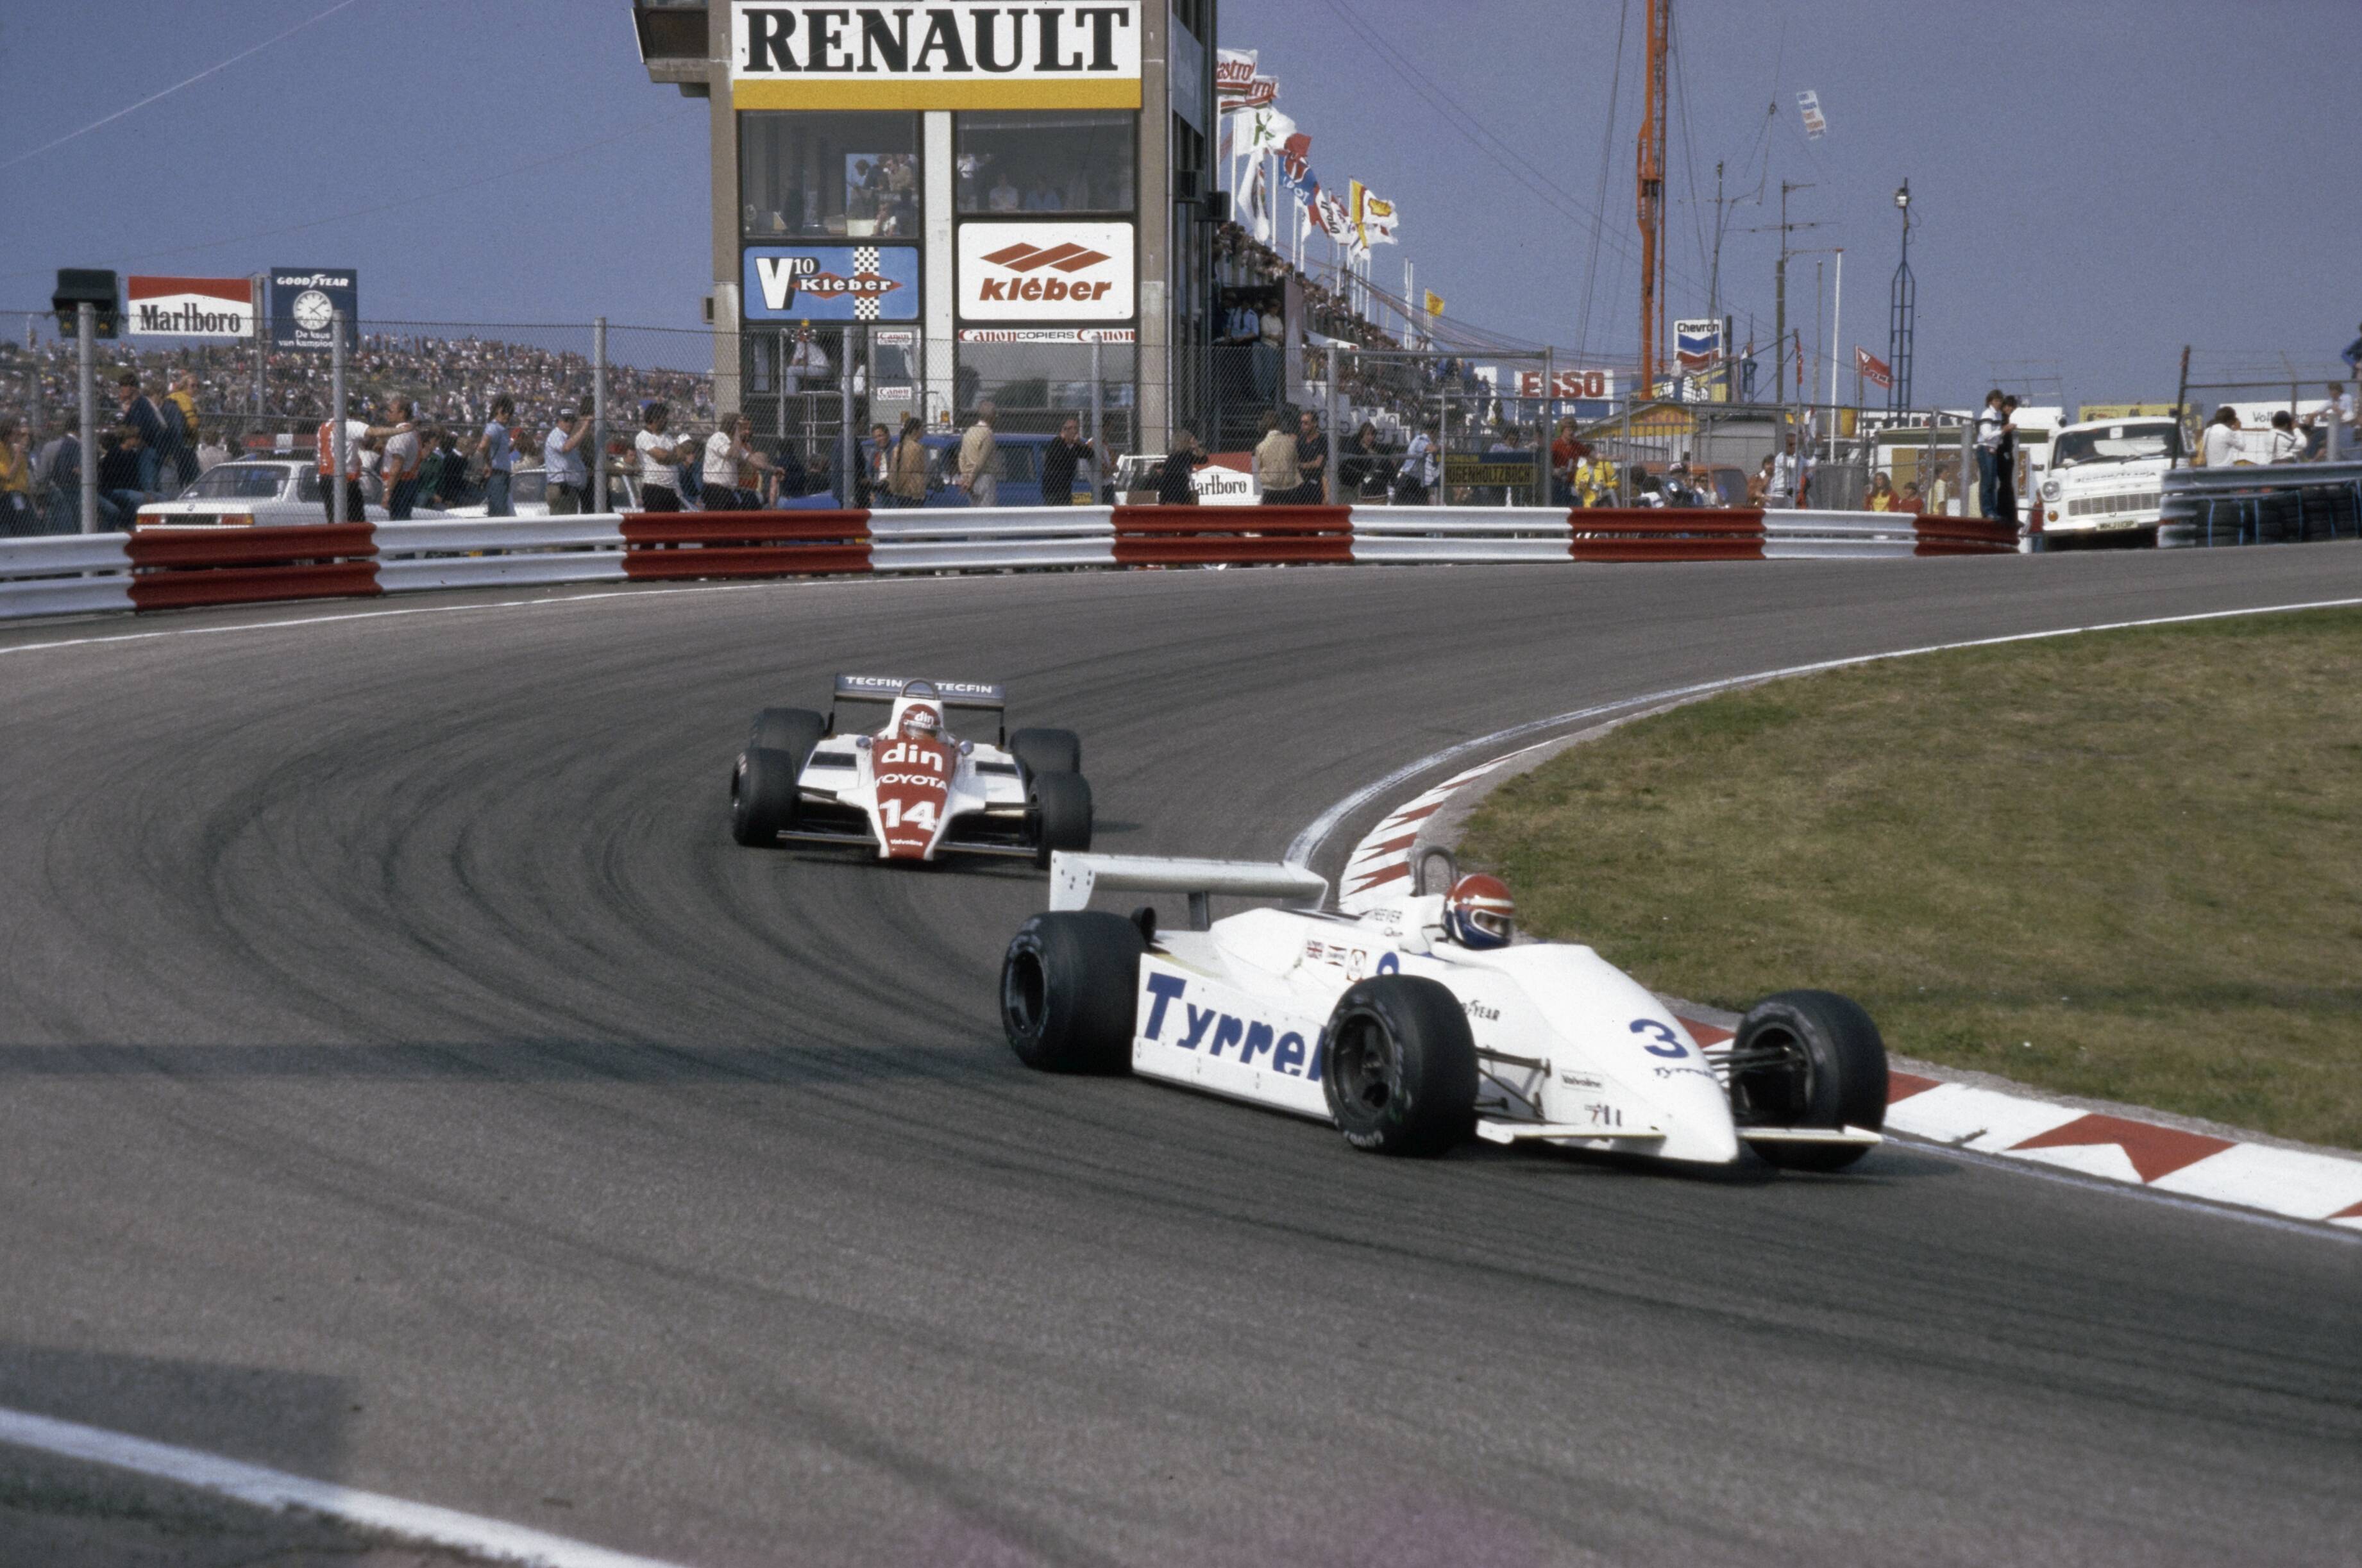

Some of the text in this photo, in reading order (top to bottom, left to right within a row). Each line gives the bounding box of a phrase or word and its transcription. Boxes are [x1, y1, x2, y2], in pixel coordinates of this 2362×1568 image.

[742, 8, 1129, 72] RENAULT
[979, 277, 1113, 301] kléber
[139, 303, 241, 333] Marlboro
[1677, 323, 1719, 333] Chevron
[959, 328, 1017, 342] Canon
[1017, 331, 1075, 339] COPIERS
[1522, 371, 1604, 398] ESSO
[1191, 475, 1247, 495] arlboro
[845, 676, 992, 694] TECFIN TECFIN
[914, 711, 934, 725] din
[881, 742, 943, 772] din
[879, 798, 939, 832] 14
[1629, 1018, 1689, 1058] 3
